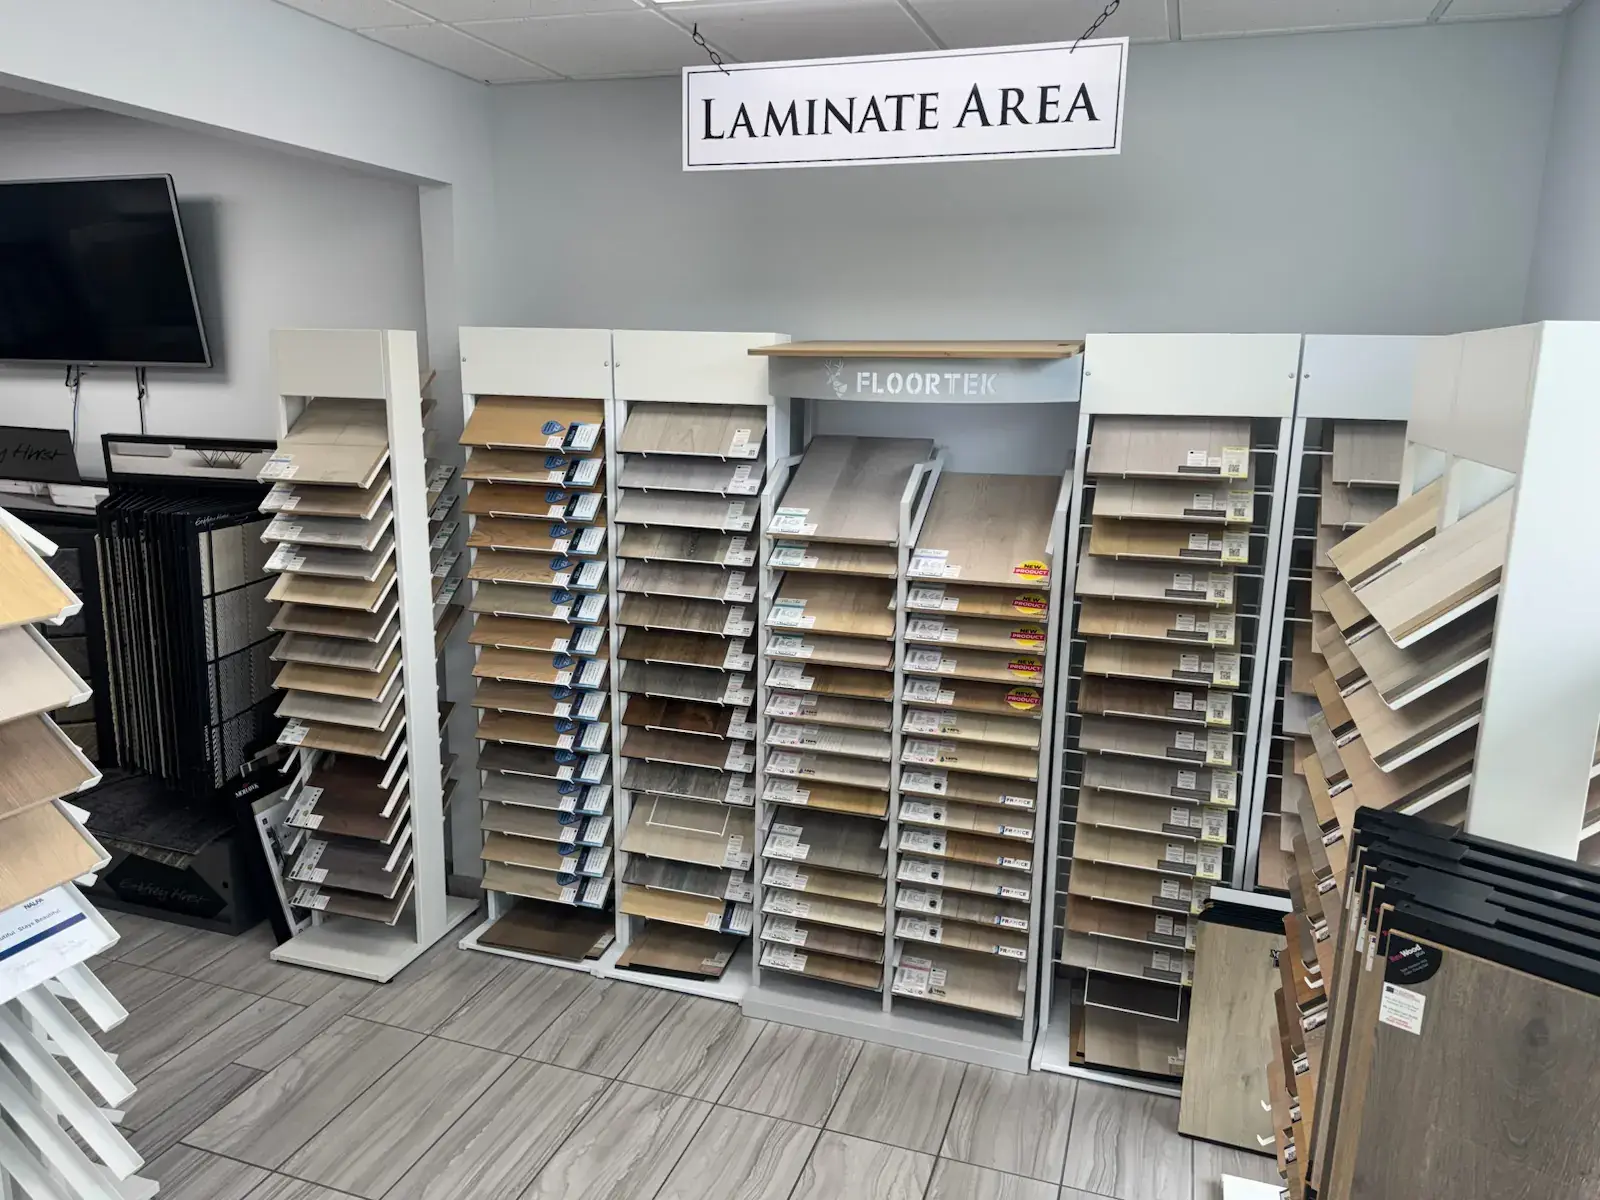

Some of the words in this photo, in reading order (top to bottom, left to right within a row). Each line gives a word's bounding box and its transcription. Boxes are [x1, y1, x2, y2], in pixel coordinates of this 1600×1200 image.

[700, 91, 940, 141] LAMINATE
[953, 82, 1101, 129] AREA
[856, 371, 1000, 396] FLOORTEK
[1015, 568, 1049, 576] PRODUCT
[1014, 601, 1047, 609] PRODUCT
[1007, 695, 1040, 704] PRODUCT
[1006, 797, 1031, 805] FRANCE
[1005, 827, 1030, 835] FRANCE
[1004, 859, 1028, 867] FRANCE
[1002, 888, 1026, 896] FRANCE
[1001, 918, 1025, 926] FRANCE
[999, 947, 1023, 956] FRANCE
